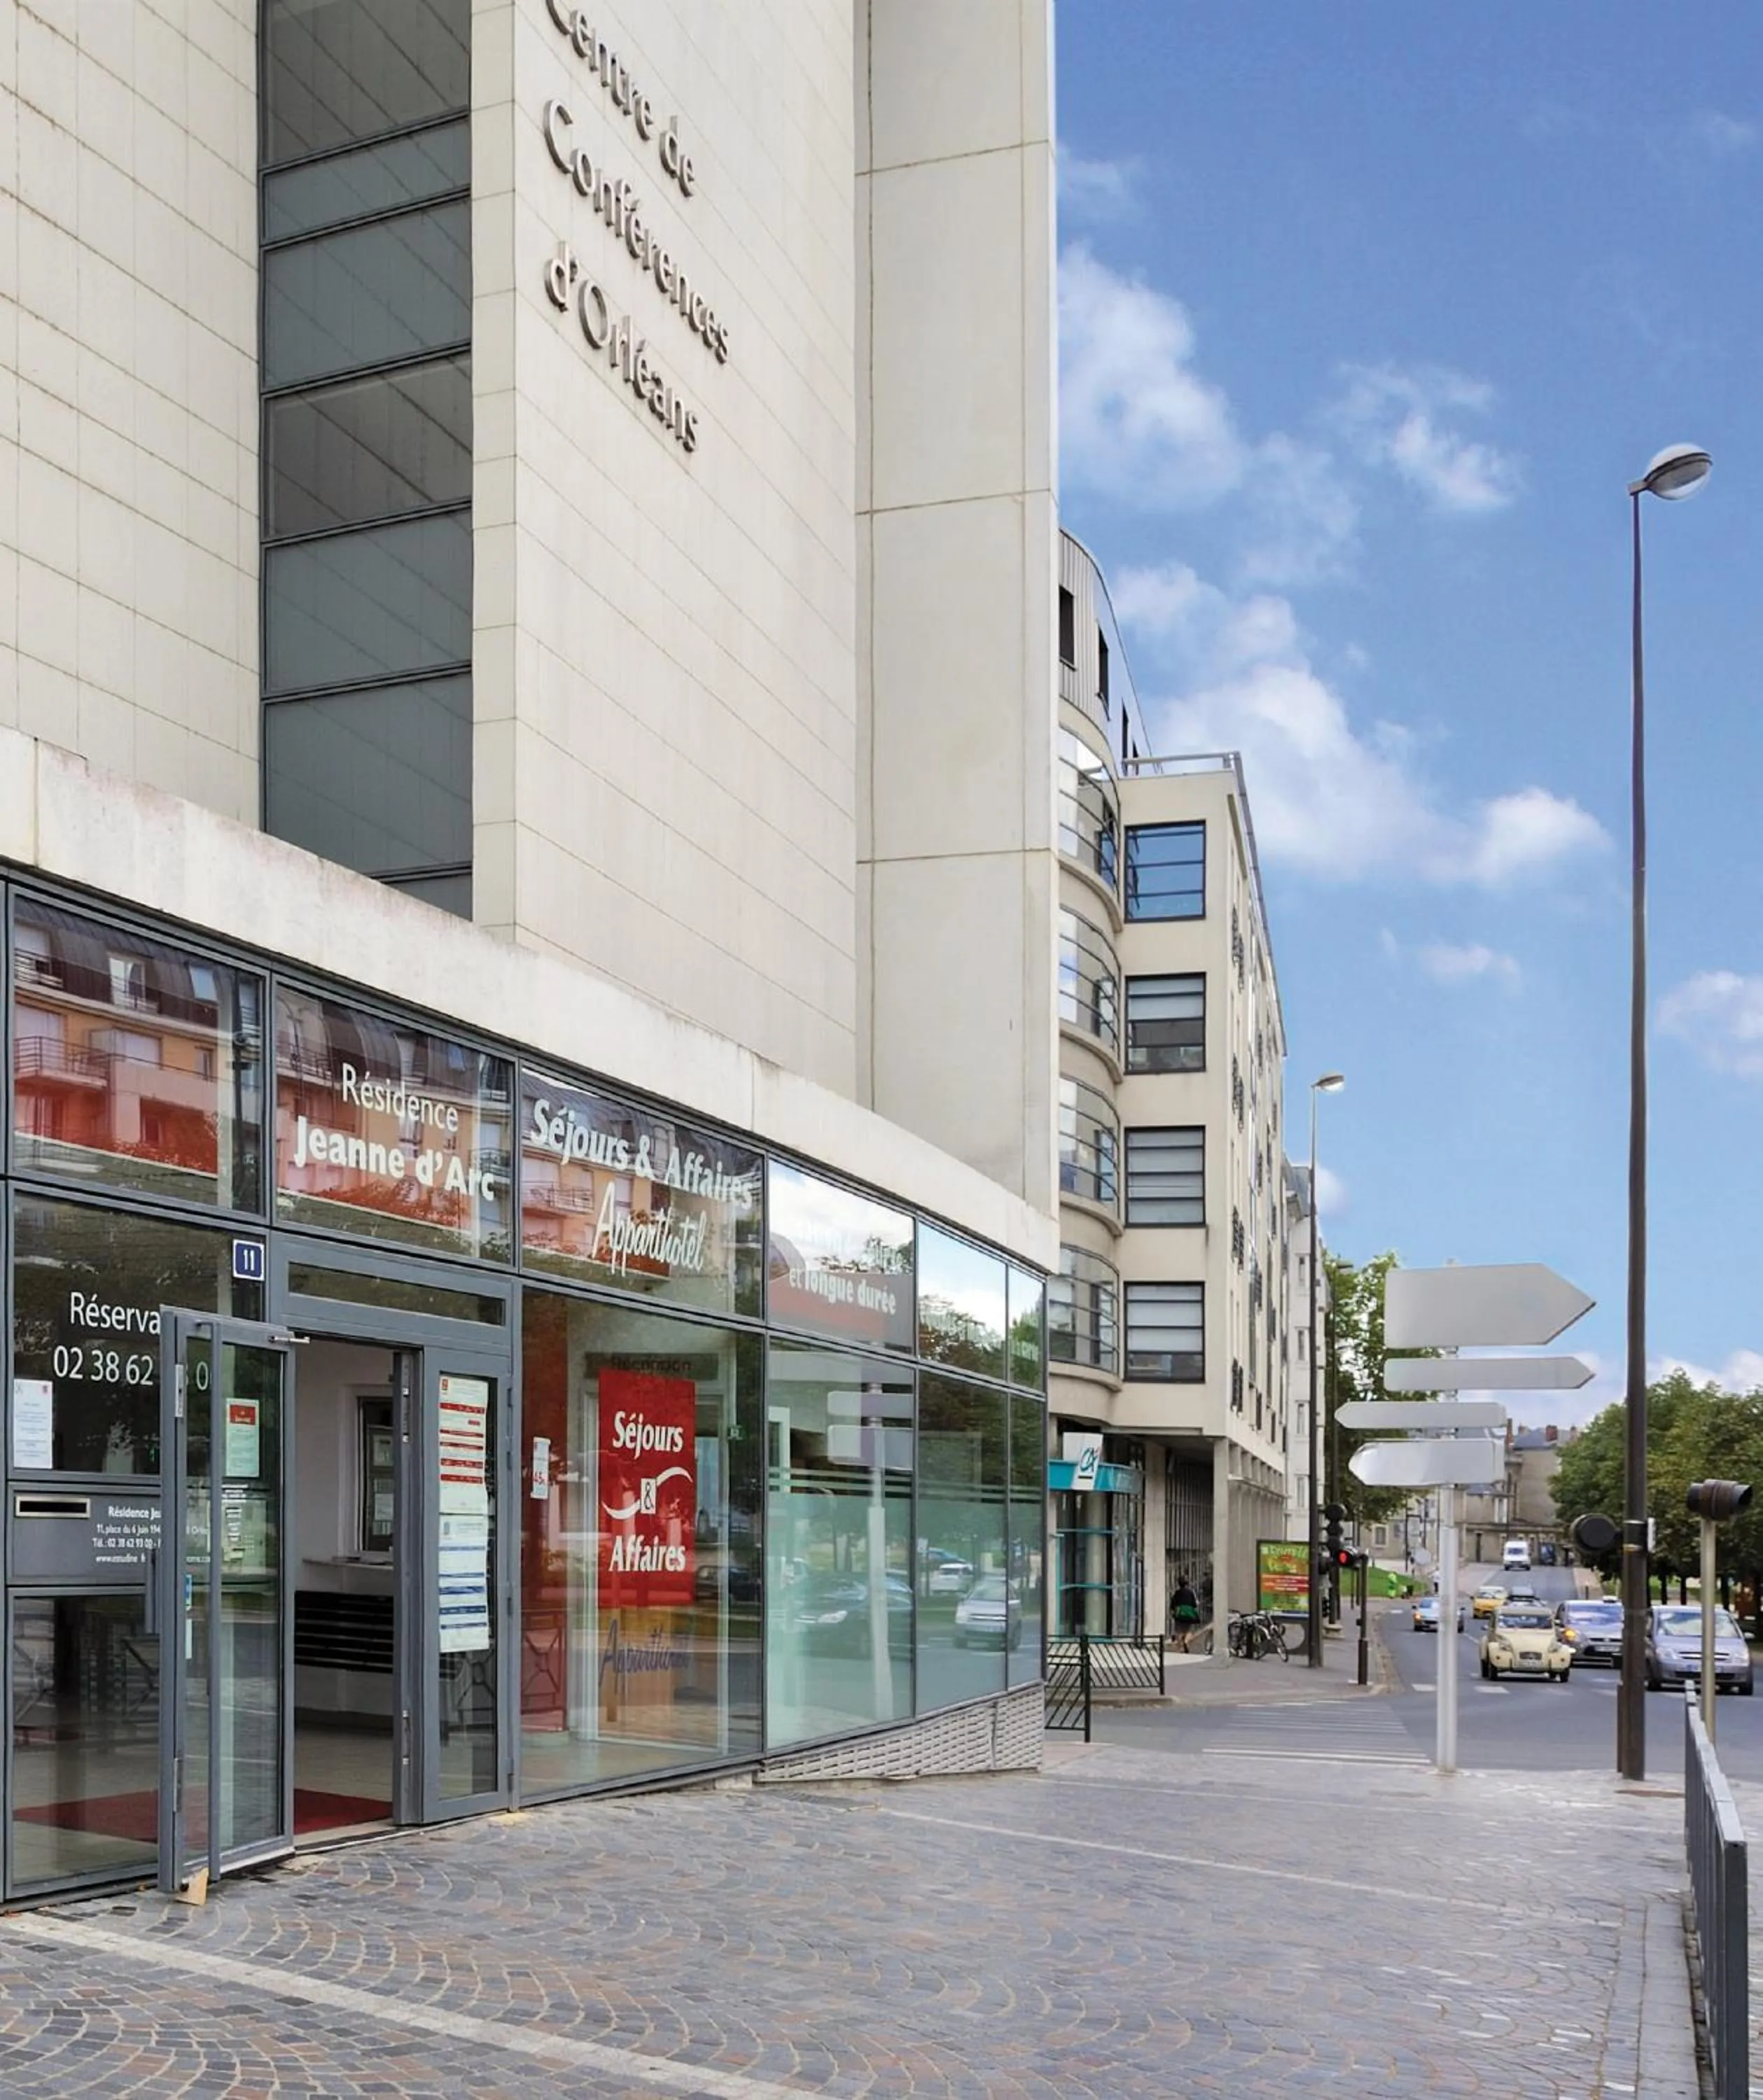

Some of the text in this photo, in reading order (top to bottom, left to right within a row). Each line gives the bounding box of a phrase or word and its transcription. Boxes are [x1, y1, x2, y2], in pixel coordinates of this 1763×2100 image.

[660, 115, 695, 197] de
[543, 98, 730, 365] Conférences
[342, 1062, 459, 1133] Résidence
[293, 1115, 496, 1202] Jeanne d'Arc
[530, 1098, 753, 1210] Séjours & Affaires
[243, 1248, 255, 1271] 11
[857, 1279, 897, 1315] durée
[53, 1345, 83, 1380] 02
[90, 1349, 120, 1383] 38
[125, 1354, 153, 1385] 62
[612, 1410, 683, 1460] Séjours
[108, 1506, 149, 1518] Résidence
[643, 1482, 654, 1510] &
[608, 1534, 687, 1572] Affaires
